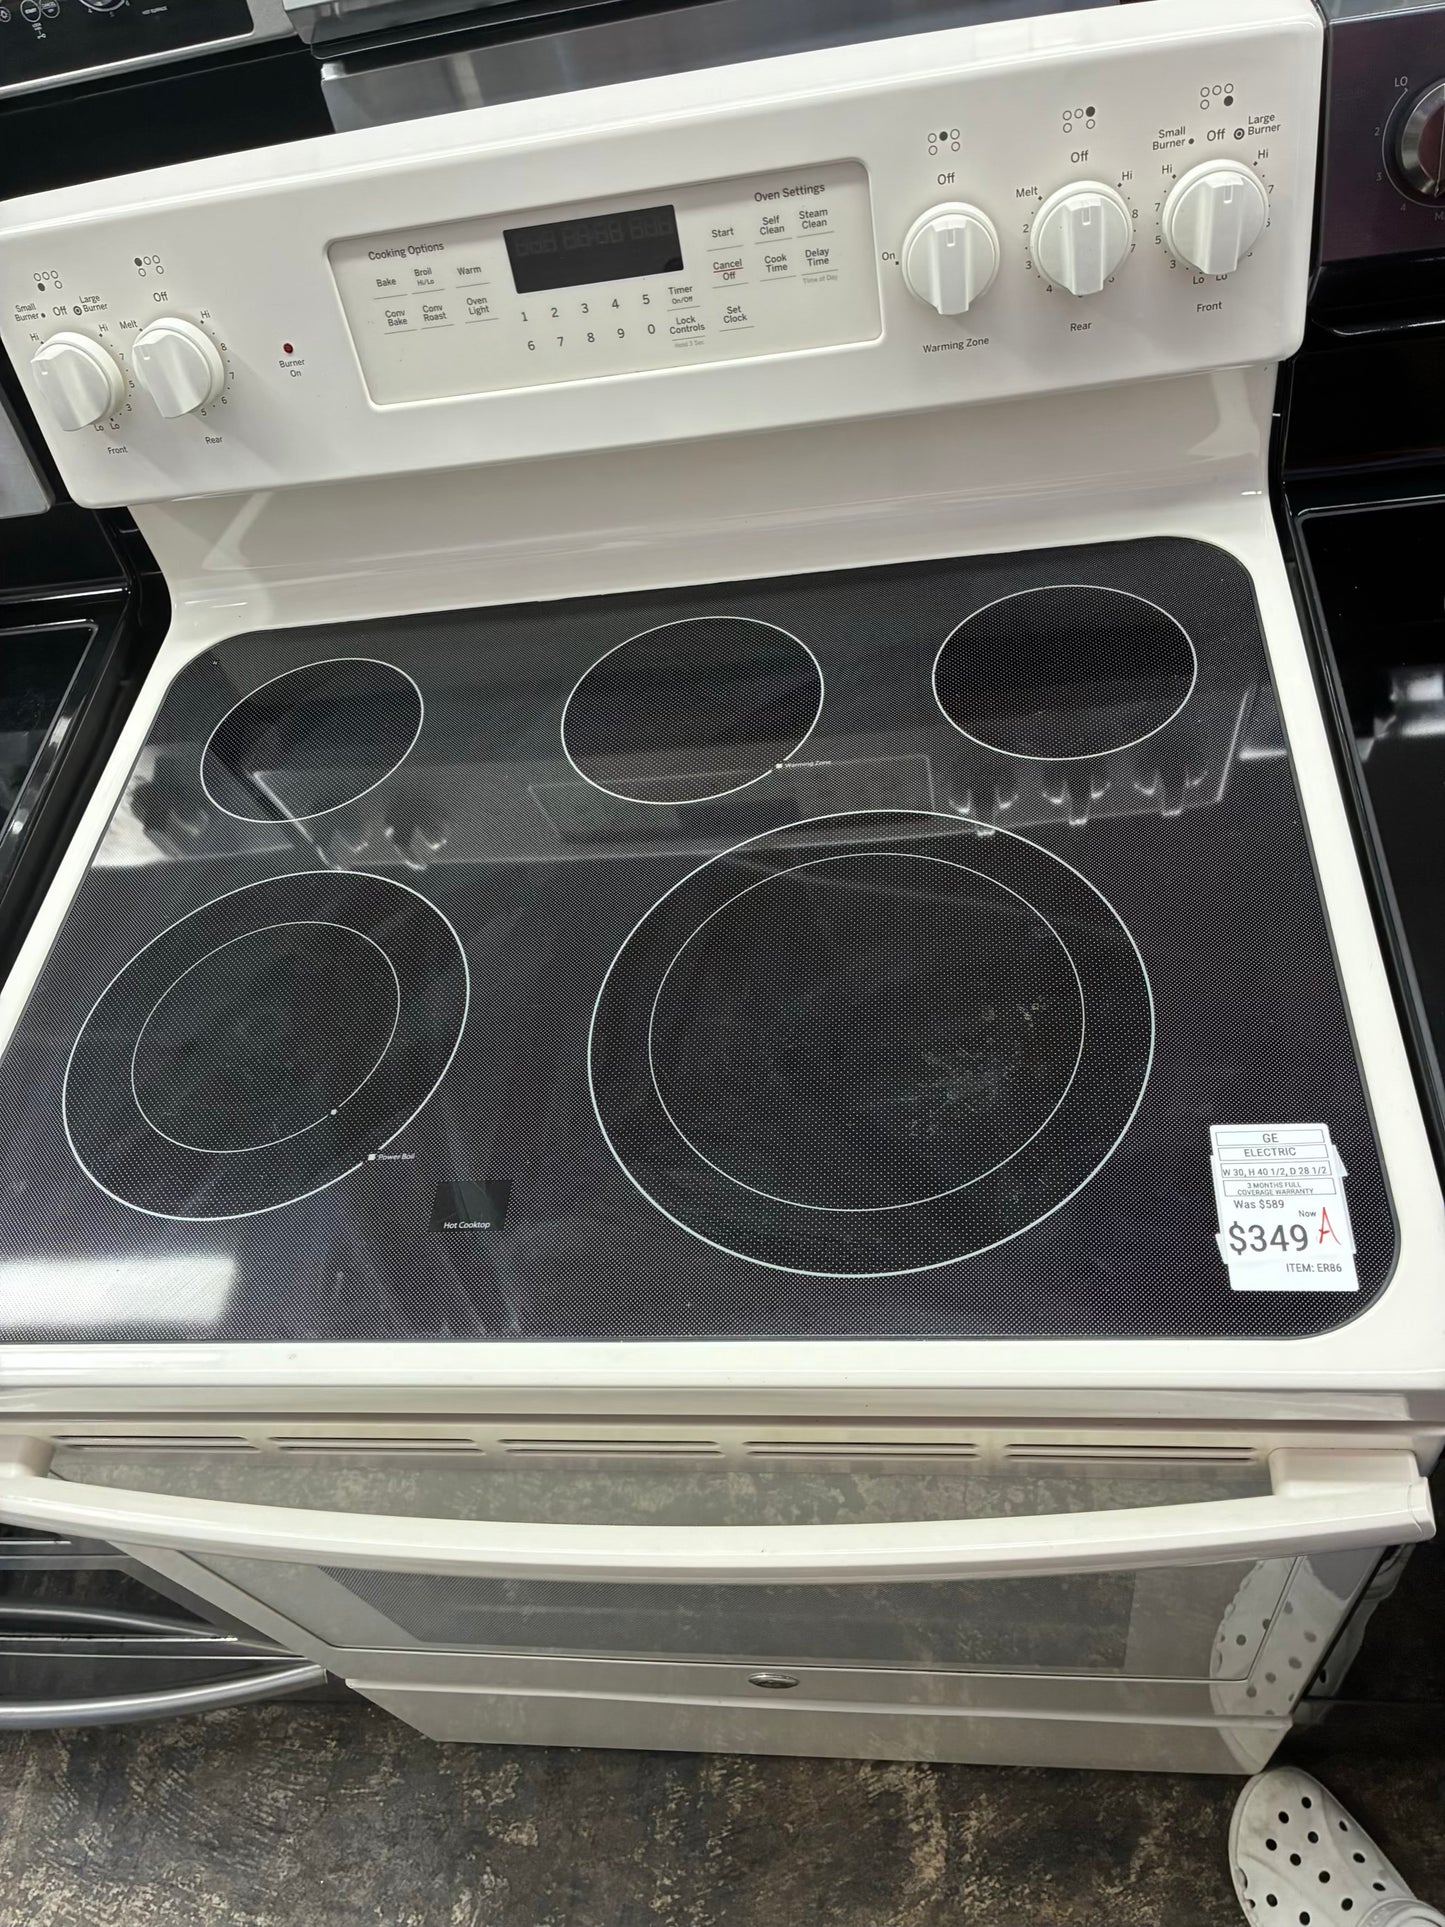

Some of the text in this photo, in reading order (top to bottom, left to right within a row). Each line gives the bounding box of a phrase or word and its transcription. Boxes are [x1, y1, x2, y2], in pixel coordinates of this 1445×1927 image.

[1394, 76, 1408, 87] LO
[1248, 113, 1275, 126] Large
[1158, 126, 1186, 139] Small
[1248, 123, 1281, 136] Burner
[1374, 127, 1381, 136] 2
[1206, 129, 1225, 142] Off
[1152, 138, 1185, 150] Burner
[1070, 150, 1089, 163] Off
[1257, 149, 1269, 160] Hi
[1161, 164, 1173, 174] Hi
[937, 172, 955, 185] Off
[1122, 170, 1133, 181] Hi
[1376, 172, 1383, 181] 3
[754, 184, 825, 202] Oven Settings
[1015, 186, 1038, 198] Melt
[1268, 185, 1275, 194] 7
[1154, 203, 1161, 212] 7
[799, 208, 828, 219] Steam
[1131, 209, 1139, 219] 8
[762, 215, 780, 225] Self
[802, 219, 827, 229] Clean
[711, 227, 734, 238] Start
[759, 225, 785, 235] Clean
[1022, 224, 1030, 233] 2
[1155, 236, 1162, 245] 5
[368, 241, 445, 260] Cooking Options
[1130, 243, 1137, 252] 7
[805, 248, 830, 259] Delay
[881, 251, 896, 261] On
[764, 254, 787, 264] Cook
[807, 257, 829, 267] Time
[713, 259, 742, 270] Cancel
[766, 263, 788, 273] Time
[1025, 261, 1032, 270] 3
[1169, 260, 1177, 269] 3
[414, 267, 432, 277] Broil
[457, 265, 482, 276] Warm
[722, 271, 736, 281] Off
[802, 276, 818, 285] Time
[826, 274, 838, 282] Day
[1192, 275, 1205, 285] Lo
[376, 278, 397, 288] Bake
[417, 278, 435, 286] Hi/Lo
[668, 285, 693, 295] Timer
[1046, 284, 1053, 293] 4
[79, 294, 101, 304] Large
[153, 291, 169, 302] Off
[466, 297, 488, 306] Oven
[672, 296, 694, 305] On/Off
[15, 303, 36, 313] Small
[52, 305, 68, 317] Off
[83, 302, 108, 313] Burner
[422, 304, 443, 313] Conv
[468, 305, 489, 316] Light
[521, 294, 650, 322] 1 2 3 4 5
[727, 305, 742, 315] Set
[1196, 300, 1223, 312] Front
[15, 311, 39, 322] Burner
[200, 310, 211, 319] Hi
[385, 309, 406, 318] Conv
[423, 312, 447, 322] Roast
[723, 313, 747, 324] Clock
[119, 320, 138, 330] Melt
[388, 318, 408, 327] Bake
[676, 315, 696, 325] Lock
[98, 323, 109, 332] Hi
[670, 323, 705, 335] Controls
[1070, 321, 1092, 332] Rear
[30, 332, 40, 341] Hi
[527, 324, 656, 351] 6 7 8 9 0
[221, 342, 227, 351] 8
[923, 336, 990, 353] Warming Zone
[119, 352, 125, 361] 7
[279, 360, 305, 368] Burner
[229, 372, 235, 380] 7
[290, 369, 302, 377] On
[129, 380, 135, 388] 5
[221, 397, 227, 405] 6
[126, 403, 132, 412] 3
[201, 408, 207, 416] 5
[94, 422, 120, 432] Lo Lo
[205, 435, 223, 445] Rear
[107, 445, 128, 455] Front
[1262, 1133, 1279, 1143] GE
[1244, 1147, 1297, 1157] ELECTRIC
[1222, 1166, 1327, 1178] W 30, H 40 1/2, D 28 1/2
[1253, 1181, 1284, 1189] MONTHS
[1276, 1188, 1314, 1196] WARRANTY
[1233, 1199, 1285, 1209] Was $589
[1298, 1210, 1317, 1218] Now
[444, 1221, 491, 1231] Hot Cooktop
[1318, 1207, 1341, 1245] A
[1229, 1221, 1308, 1255] $349
[1286, 1263, 1342, 1273] ITEM: ER86
